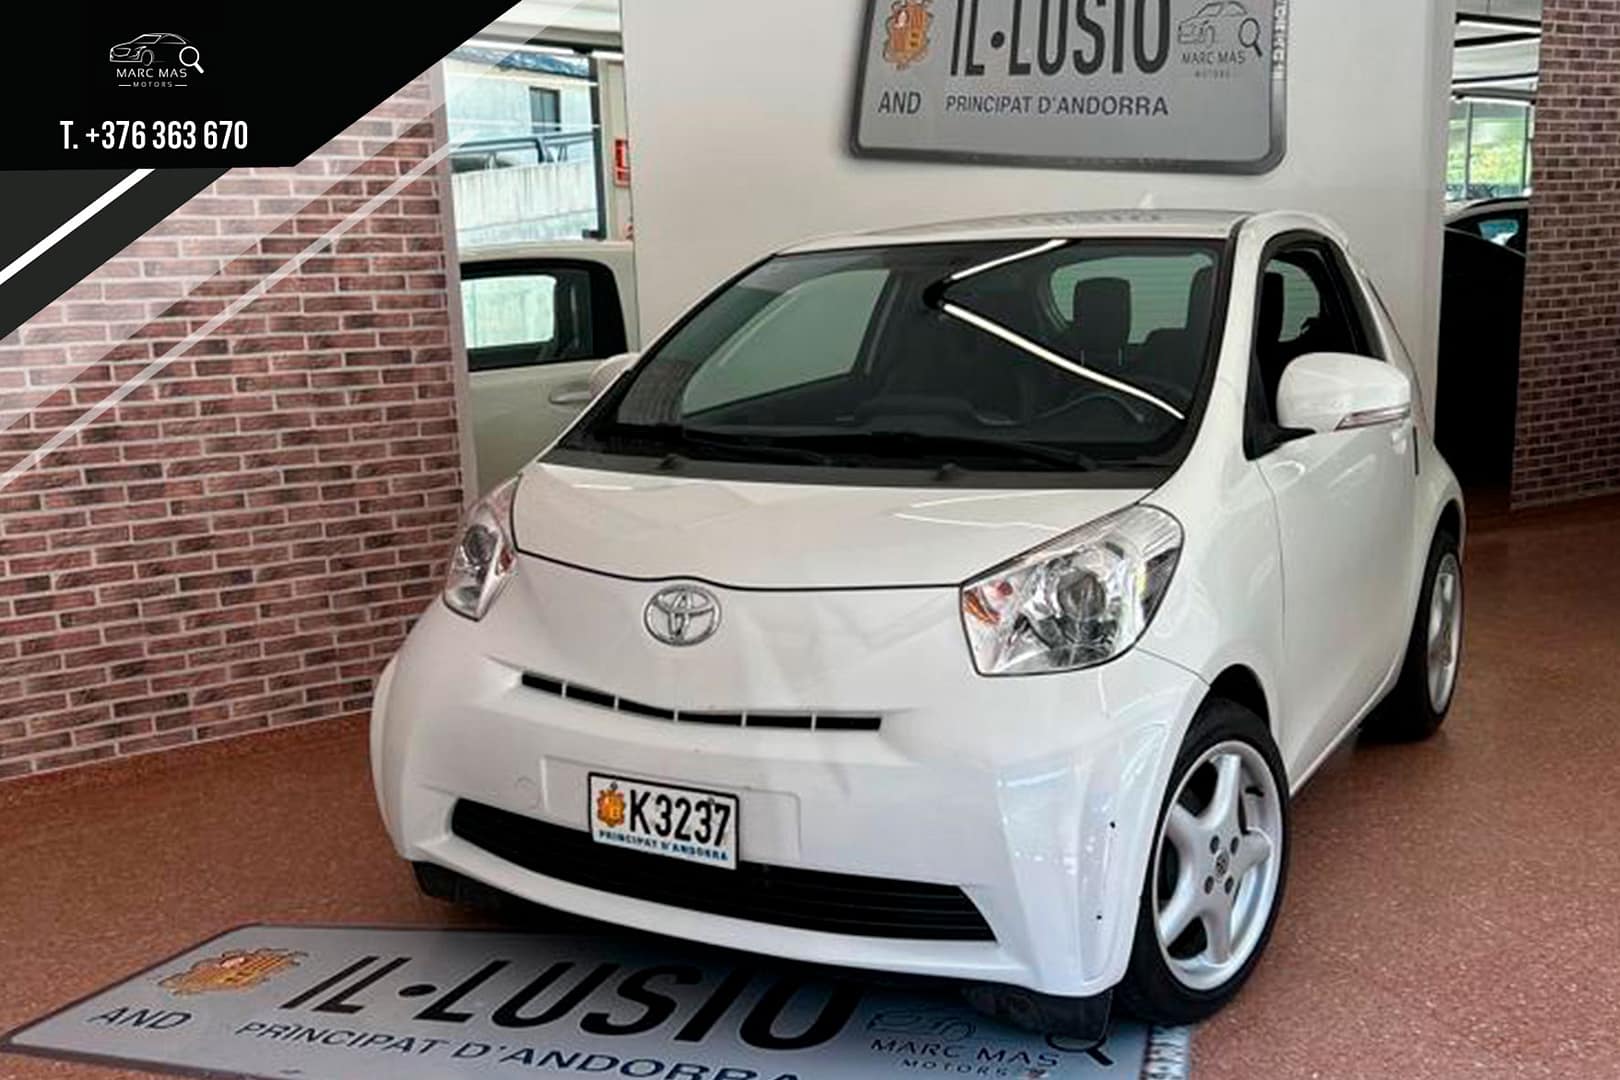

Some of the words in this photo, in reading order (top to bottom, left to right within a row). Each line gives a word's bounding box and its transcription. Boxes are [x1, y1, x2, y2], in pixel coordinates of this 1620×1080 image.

[878, 91, 921, 115] AND
[946, 95, 1033, 113] PRINCIPAT
[1038, 95, 1168, 116] D'ANDORRA
[630, 789, 731, 847] K3237
[92, 1007, 192, 1030] AND
[235, 1021, 449, 1055] PRINCIPAT
[871, 1039, 963, 1059] MARC
[977, 1047, 1060, 1067] MAS
[903, 1058, 1008, 1077] MOTORS
